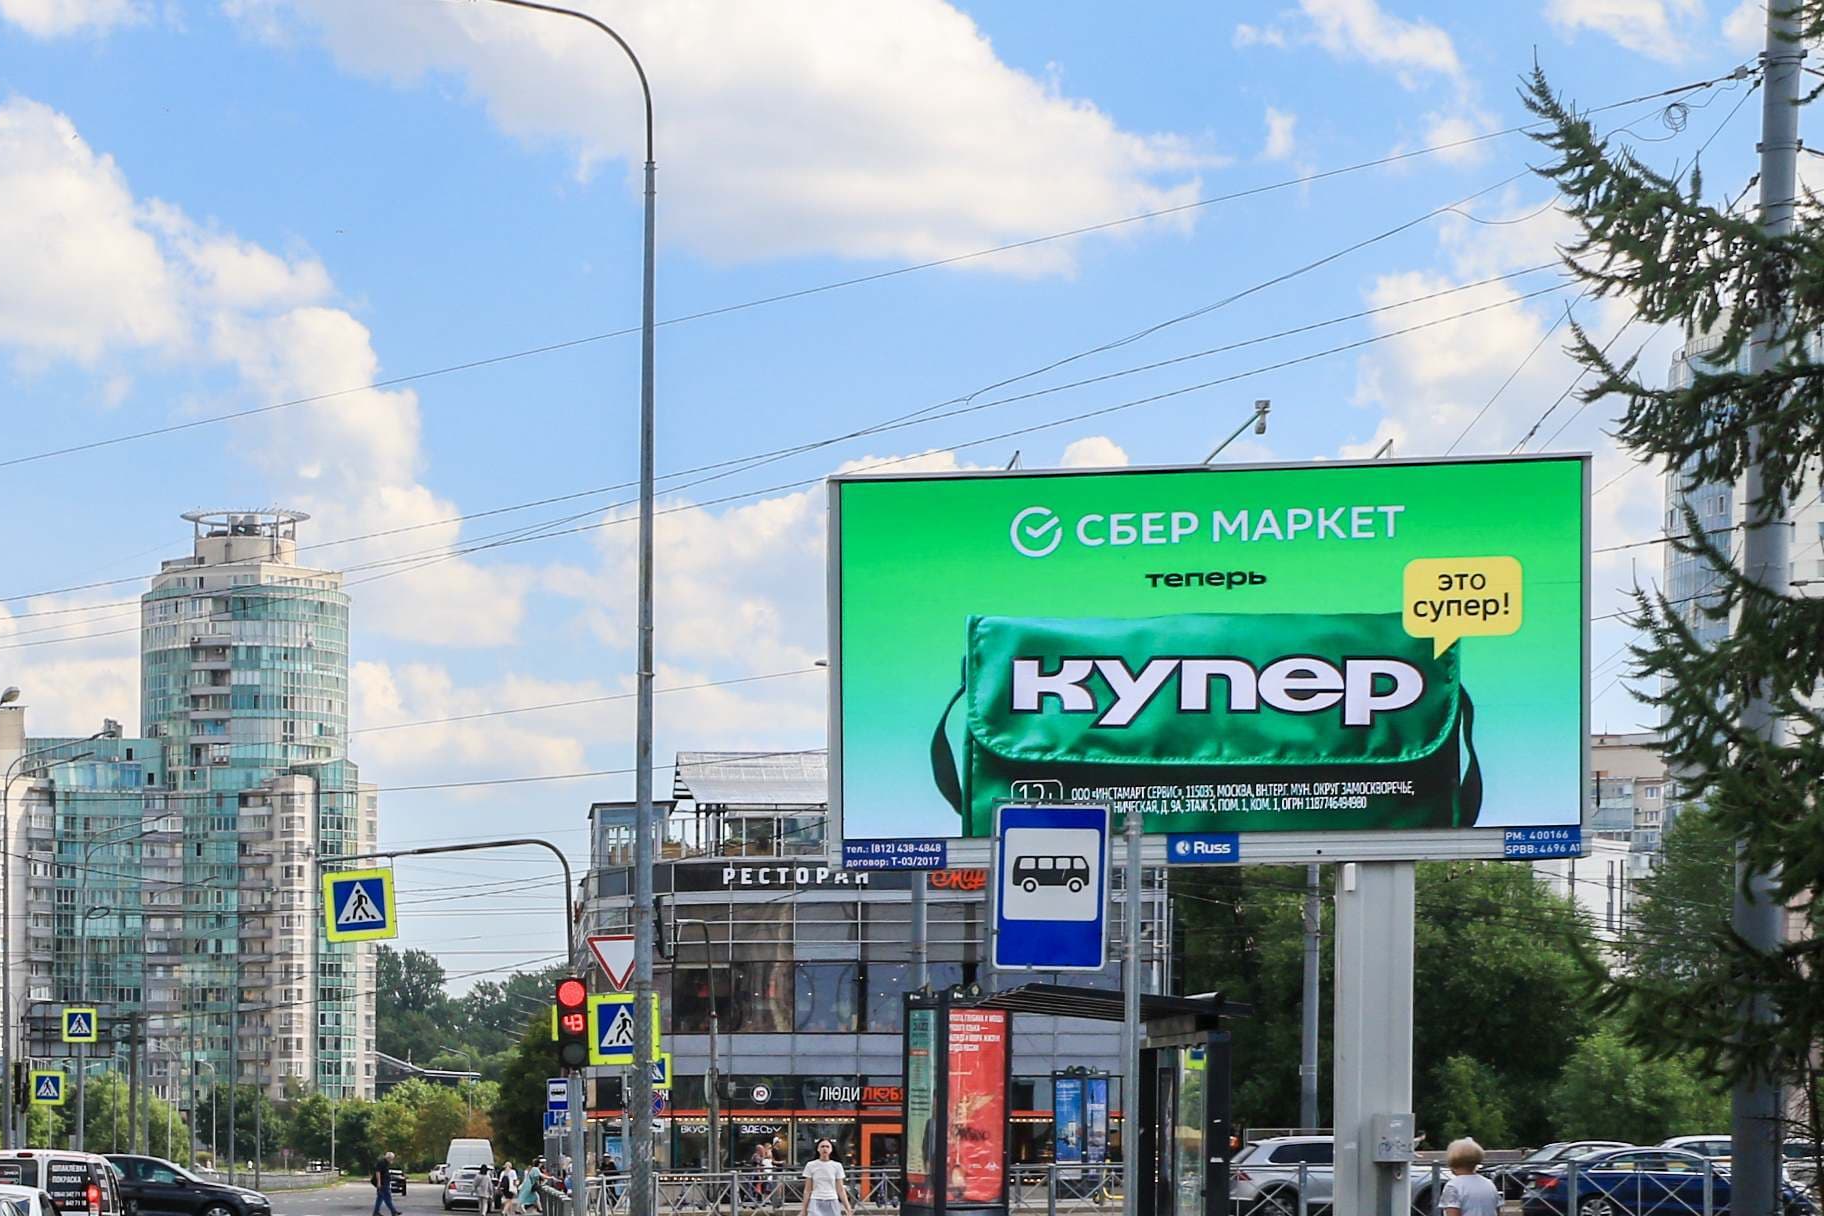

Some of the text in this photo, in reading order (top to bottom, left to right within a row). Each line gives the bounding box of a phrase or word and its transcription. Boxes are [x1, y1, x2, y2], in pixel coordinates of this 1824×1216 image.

[1076, 505, 1406, 547] СБЕР МАРКЕТ
[1145, 570, 1267, 591] теперь
[1437, 573, 1487, 591] это
[1412, 592, 1511, 622] супер!
[1012, 656, 1424, 727] купер
[1071, 788, 1090, 800] ООО
[1217, 784, 1255, 798] МОСКВА,
[1313, 782, 1340, 796] ОКРУГ
[1185, 800, 1211, 812] ЭТАЖ
[1282, 797, 1304, 809] ОГРН
[1529, 830, 1569, 840] 400166
[846, 843, 942, 854] тел.: (812) 438-4848
[1193, 840, 1232, 854] Russ
[846, 856, 940, 868] договор: Т-03/2017
[563, 1013, 584, 1032] 43
[819, 1086, 861, 1102] ЛЮДИ
[740, 1124, 774, 1134] ЗДЕСЬ
